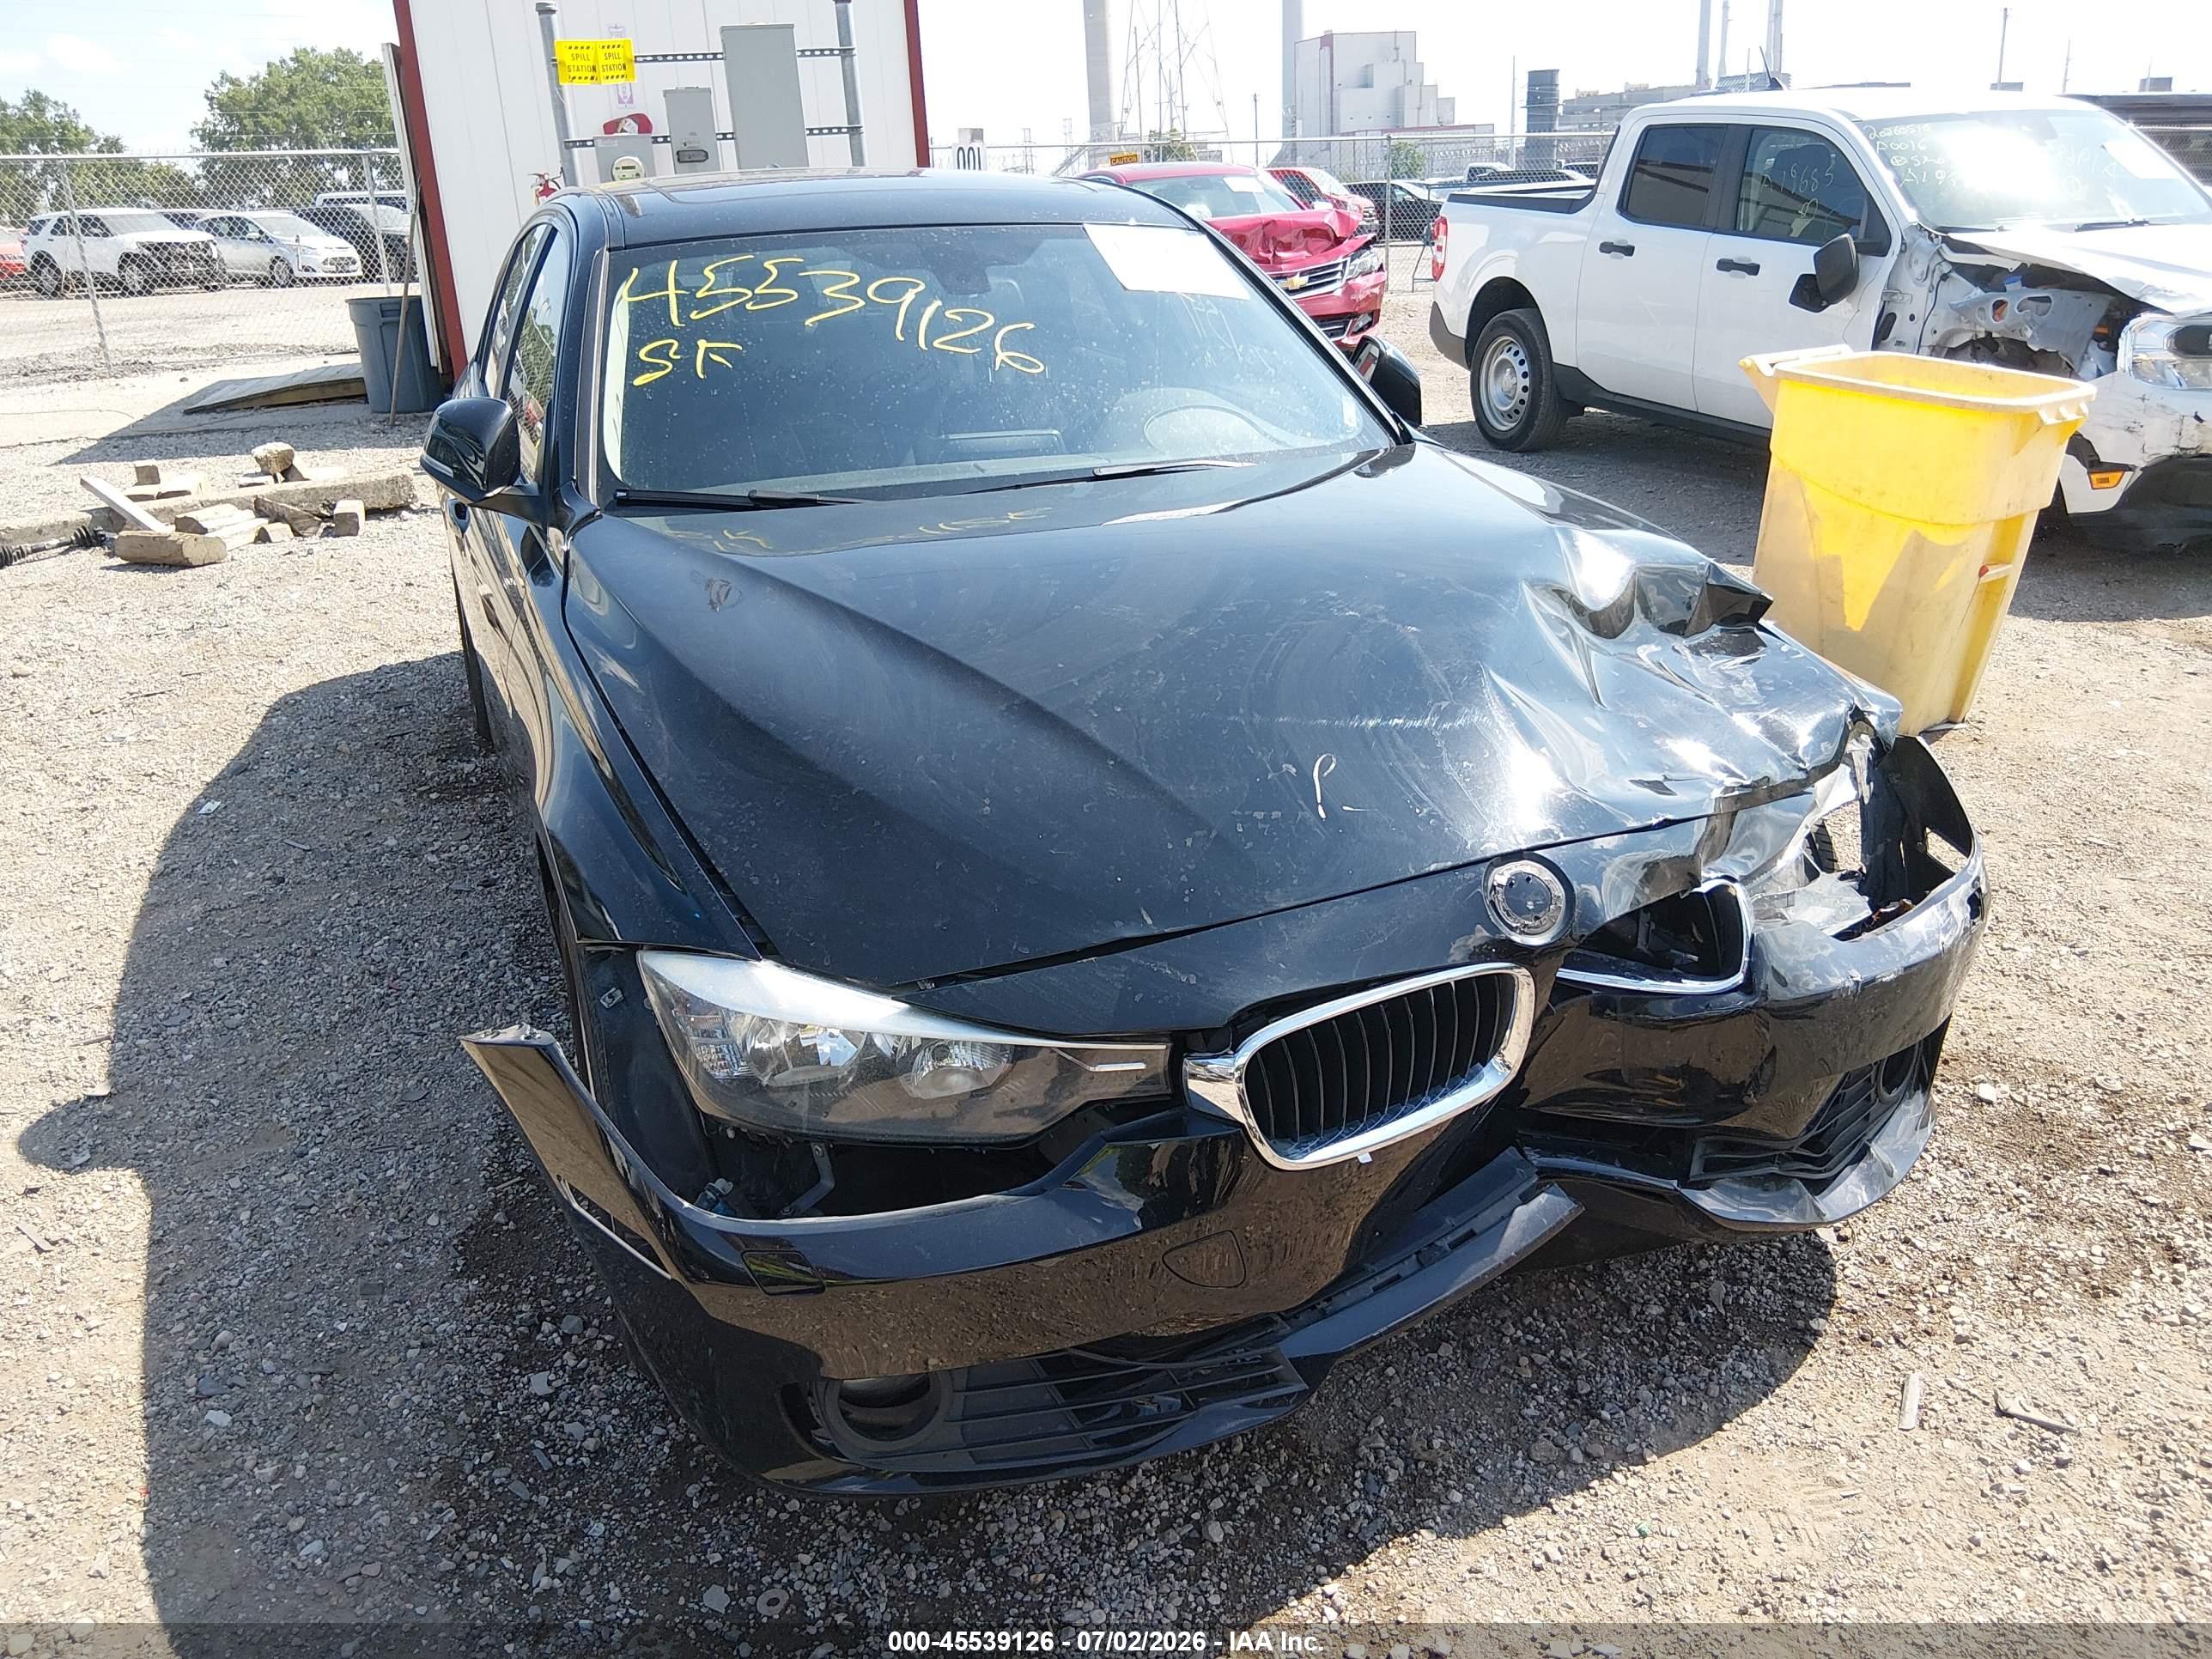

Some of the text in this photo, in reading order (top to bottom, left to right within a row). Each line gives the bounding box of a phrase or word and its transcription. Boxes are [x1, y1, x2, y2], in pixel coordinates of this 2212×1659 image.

[567, 64, 597, 73] STATION
[601, 63, 627, 72] STATION
[1111, 155, 1138, 165] CAUTION
[623, 254, 1045, 374] 45539126
